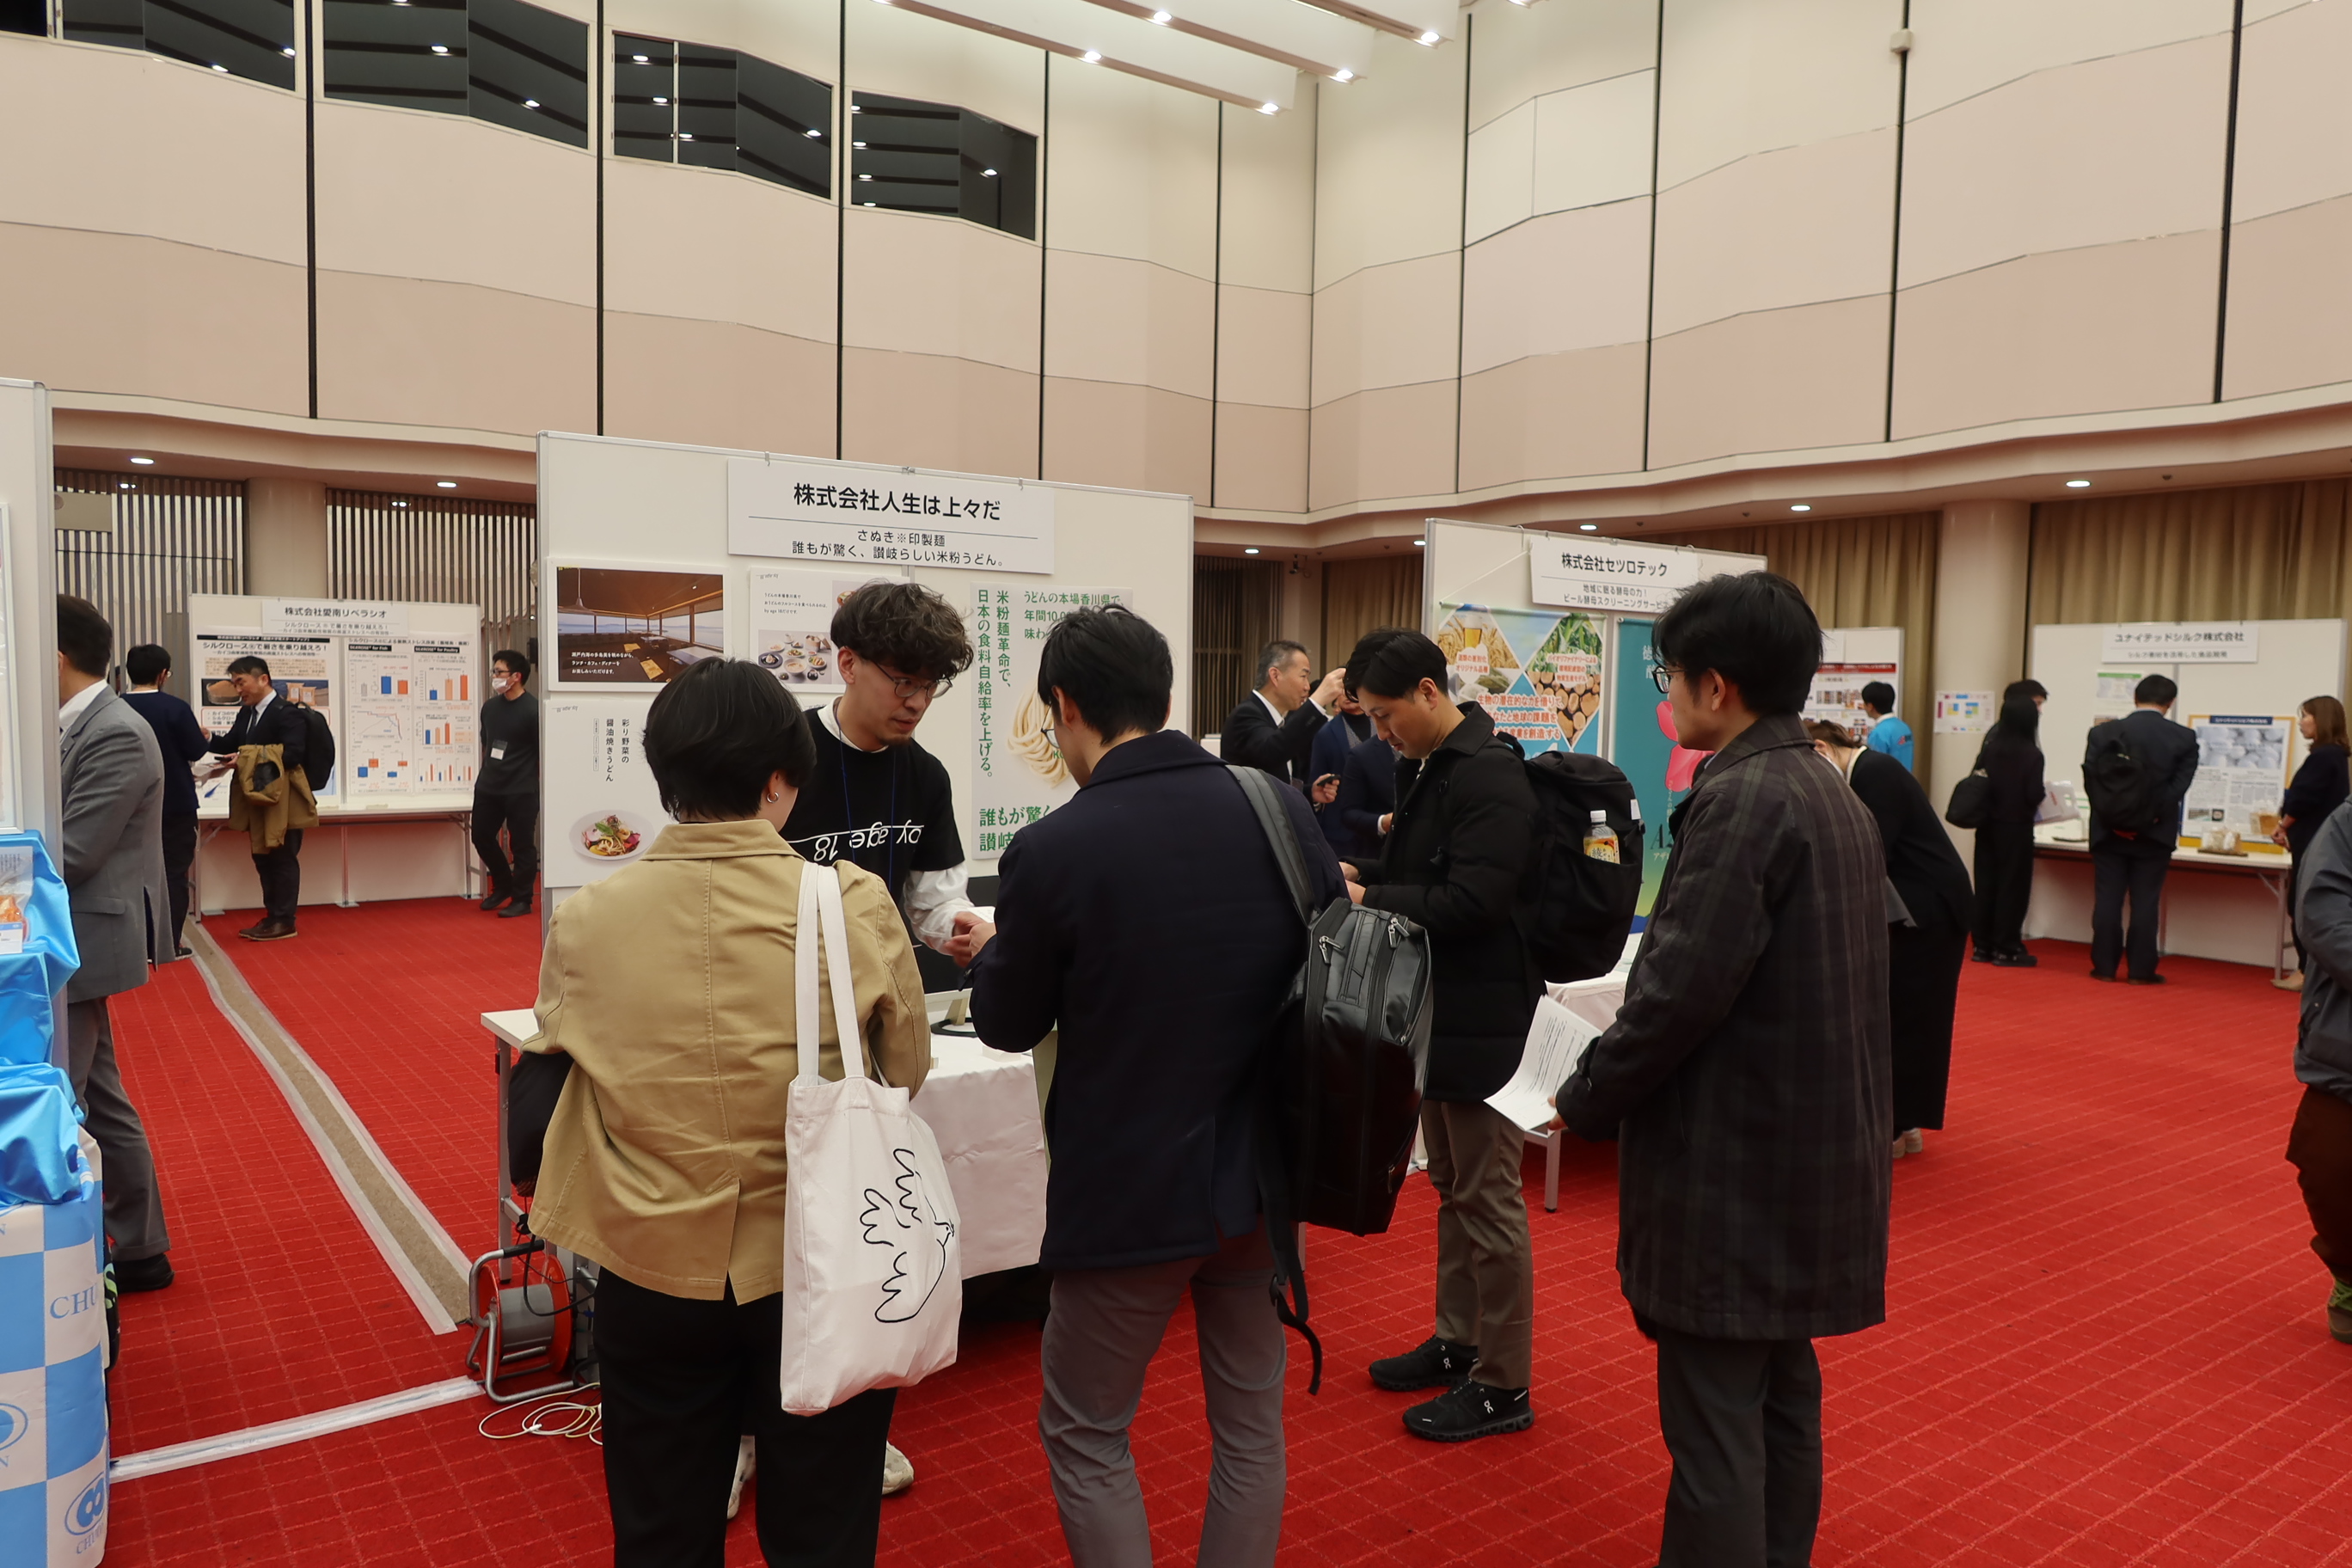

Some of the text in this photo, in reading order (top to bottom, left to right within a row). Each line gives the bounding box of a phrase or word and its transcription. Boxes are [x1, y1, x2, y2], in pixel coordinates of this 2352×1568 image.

[793, 482, 1001, 521] 株式会社人生は上々だ
[792, 540, 1004, 567] 誰もが驚く、讃岐らしい米粉うどん。
[857, 530, 946, 548] さぬき※印製麺
[1561, 552, 1669, 578] 株式会社セツロテック
[1024, 591, 1124, 605] うどんの本場香川県で、
[996, 590, 1011, 688] 米粉麺革命で、
[977, 590, 993, 777] 日本の食料自給率を上げる。
[605, 719, 615, 782] 醤油焼きうどん
